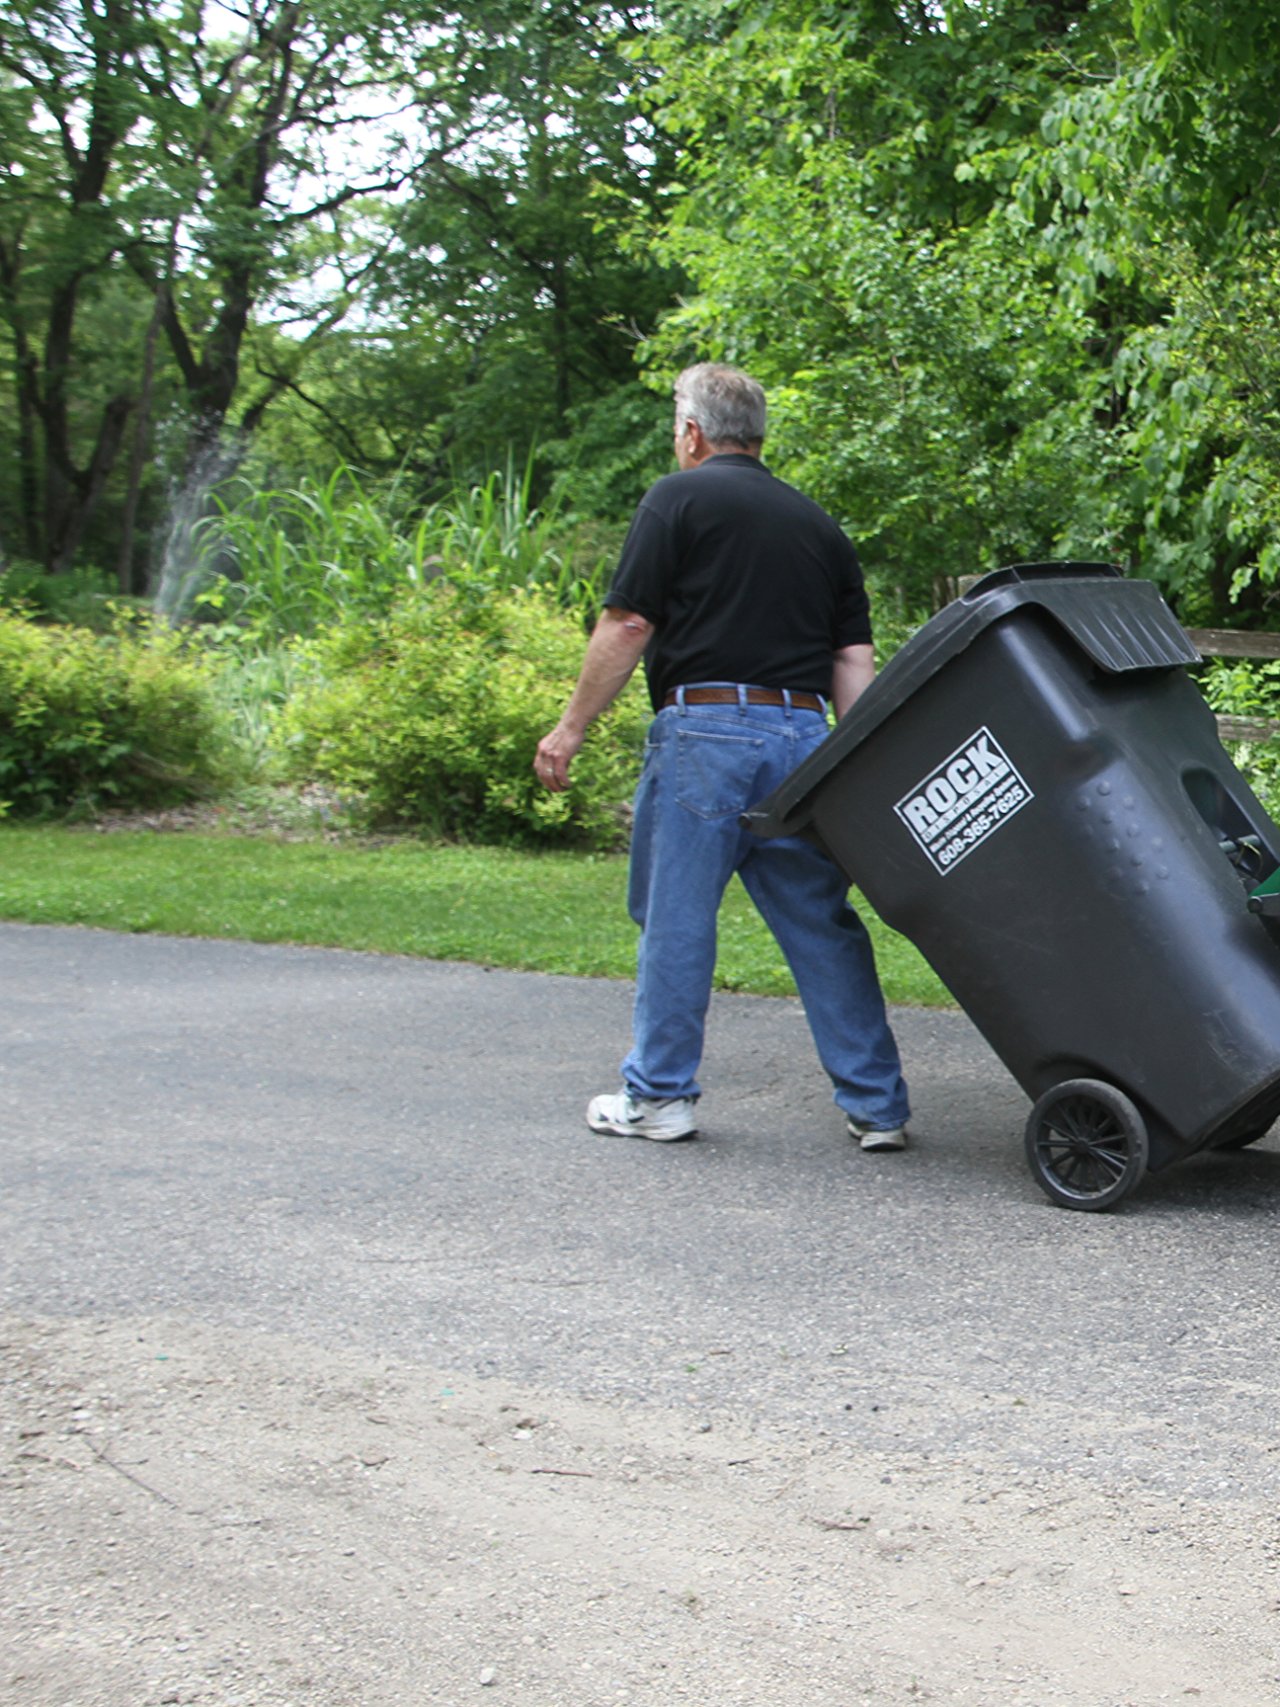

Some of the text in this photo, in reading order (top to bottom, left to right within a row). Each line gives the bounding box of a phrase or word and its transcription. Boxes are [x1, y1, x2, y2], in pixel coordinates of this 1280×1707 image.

[903, 736, 1003, 833] ROCK
[924, 770, 1000, 838] DISPOSAL
[938, 785, 1024, 864] 608-365-7625
